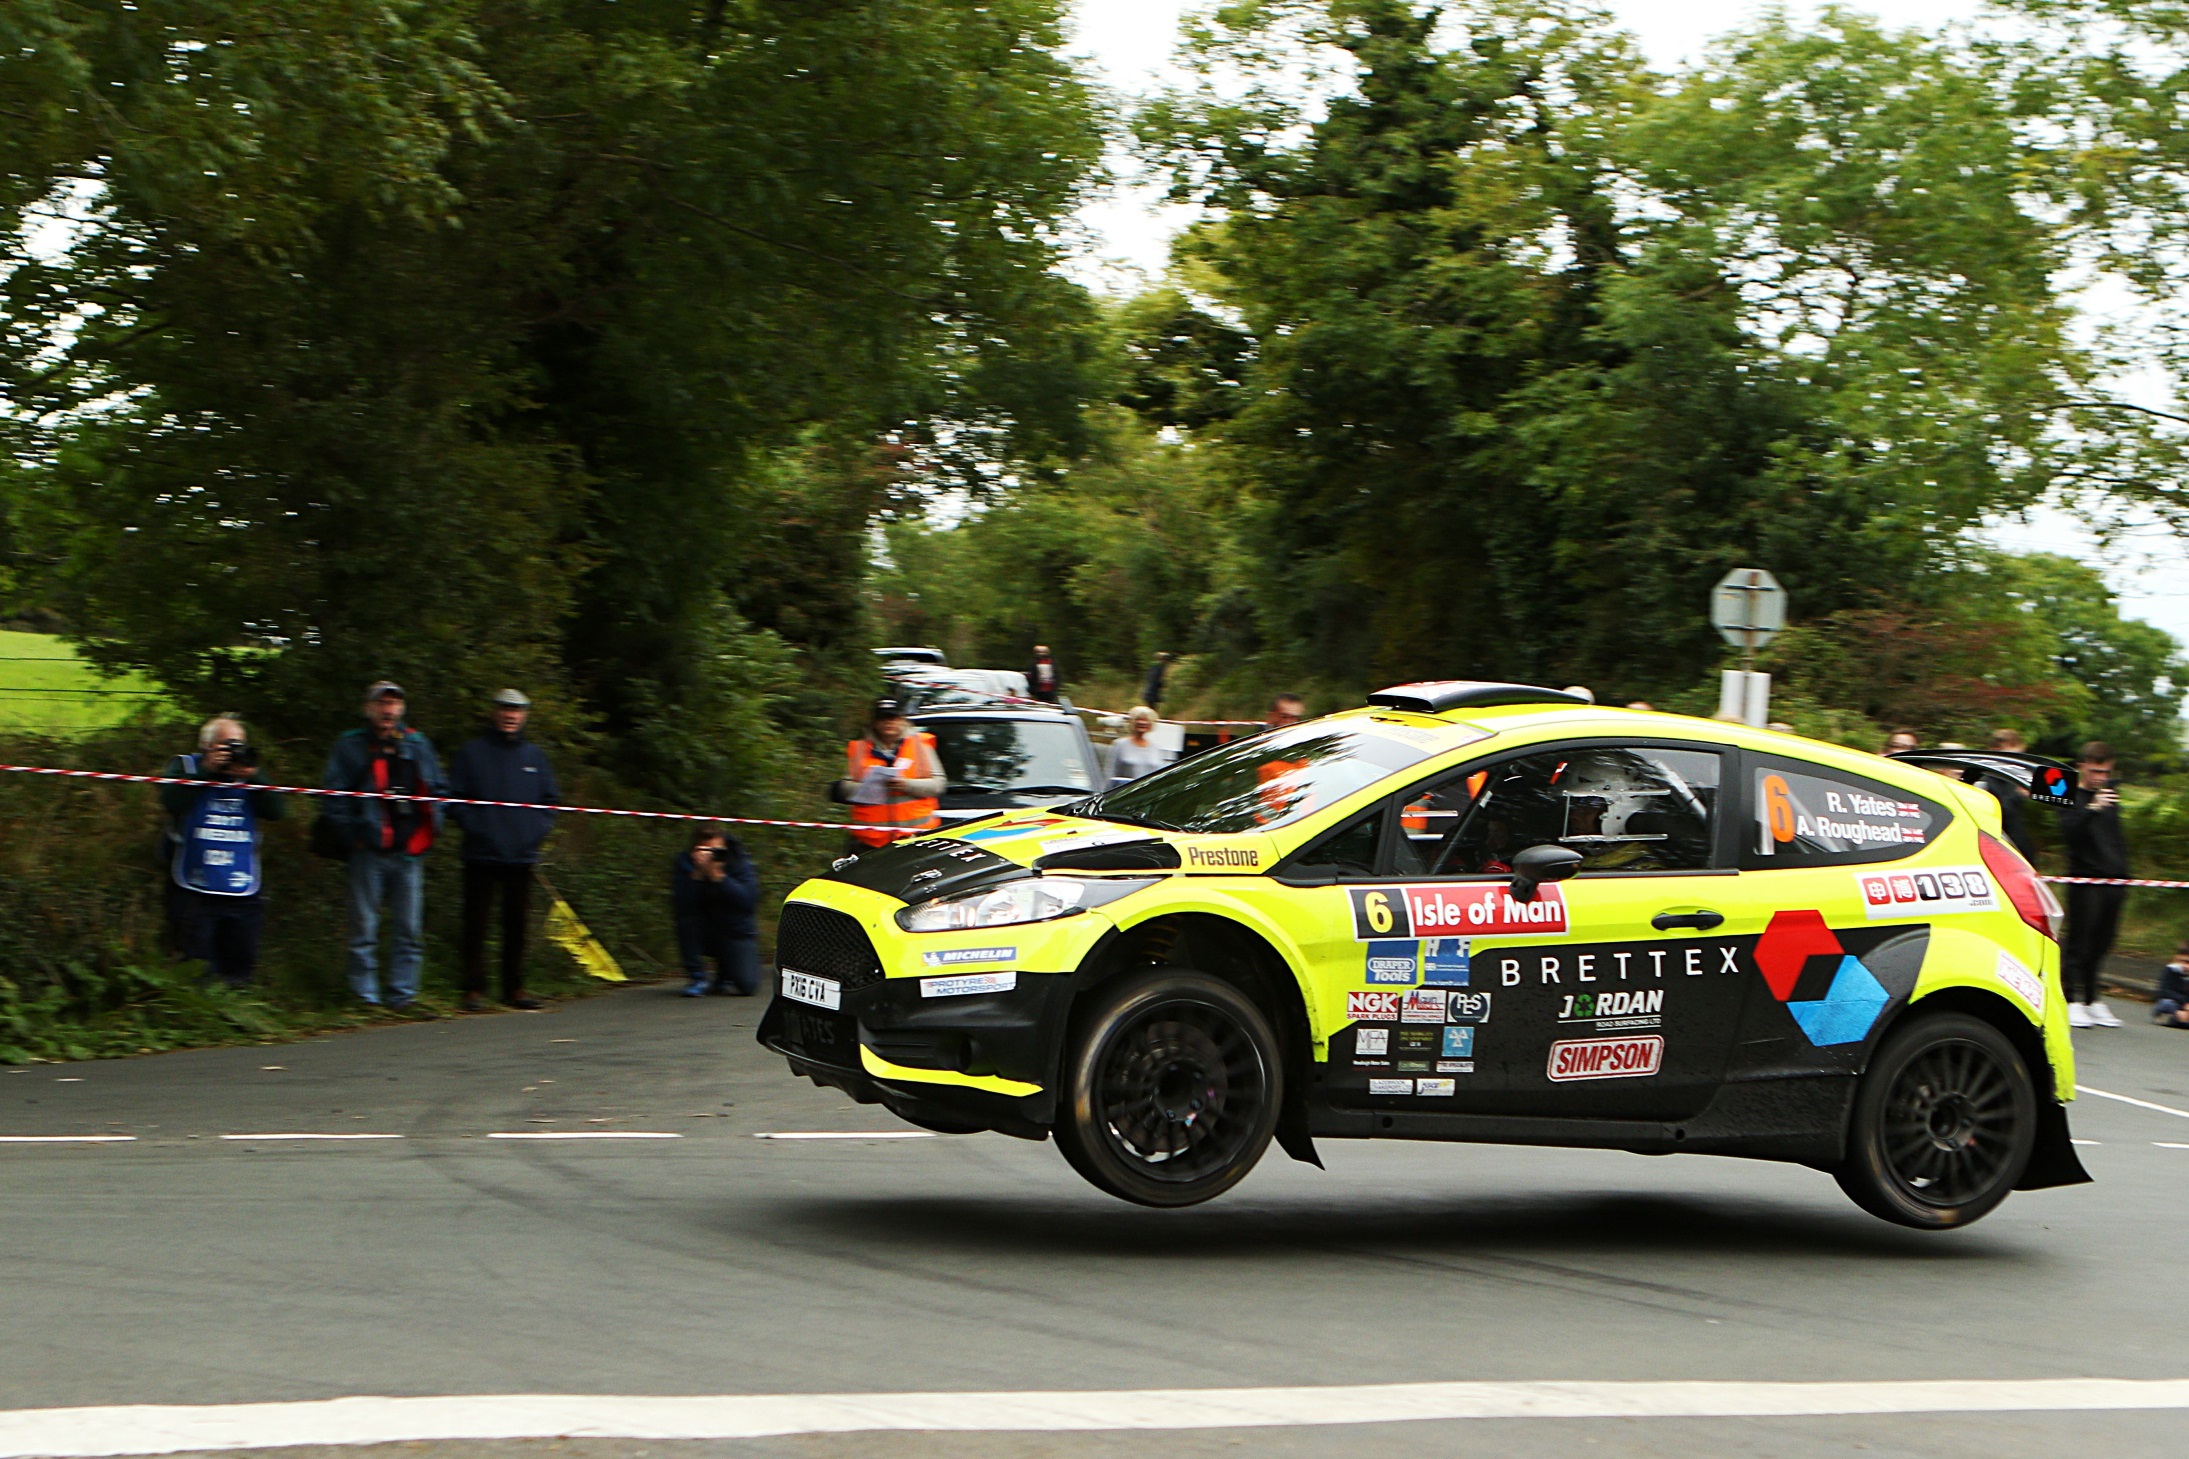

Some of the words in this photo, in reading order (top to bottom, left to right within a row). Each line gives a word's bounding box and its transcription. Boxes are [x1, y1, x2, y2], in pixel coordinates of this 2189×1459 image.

[1764, 774, 1794, 843] 6
[1826, 791, 1847, 813] R.
[1847, 793, 1897, 817] Yates
[1796, 815, 1815, 837] A.
[1815, 816, 1902, 845] Roughead
[1189, 846, 1259, 867] Prestone
[1364, 891, 1394, 934] 6
[1414, 893, 1461, 927] Isle
[1467, 892, 1496, 924] of
[1503, 894, 1562, 924] Man
[942, 949, 1014, 962] MICHELIN
[1371, 959, 1412, 970] DRAPER
[1501, 947, 1739, 987] BRETTEX
[930, 977, 985, 989] PROTYRE
[936, 981, 1015, 995] MOTORSPORT
[1373, 971, 1411, 982] Tools
[808, 979, 826, 1003] CVA
[1348, 993, 1397, 1012] NGK
[1557, 1042, 1655, 1075] SIMPSON
